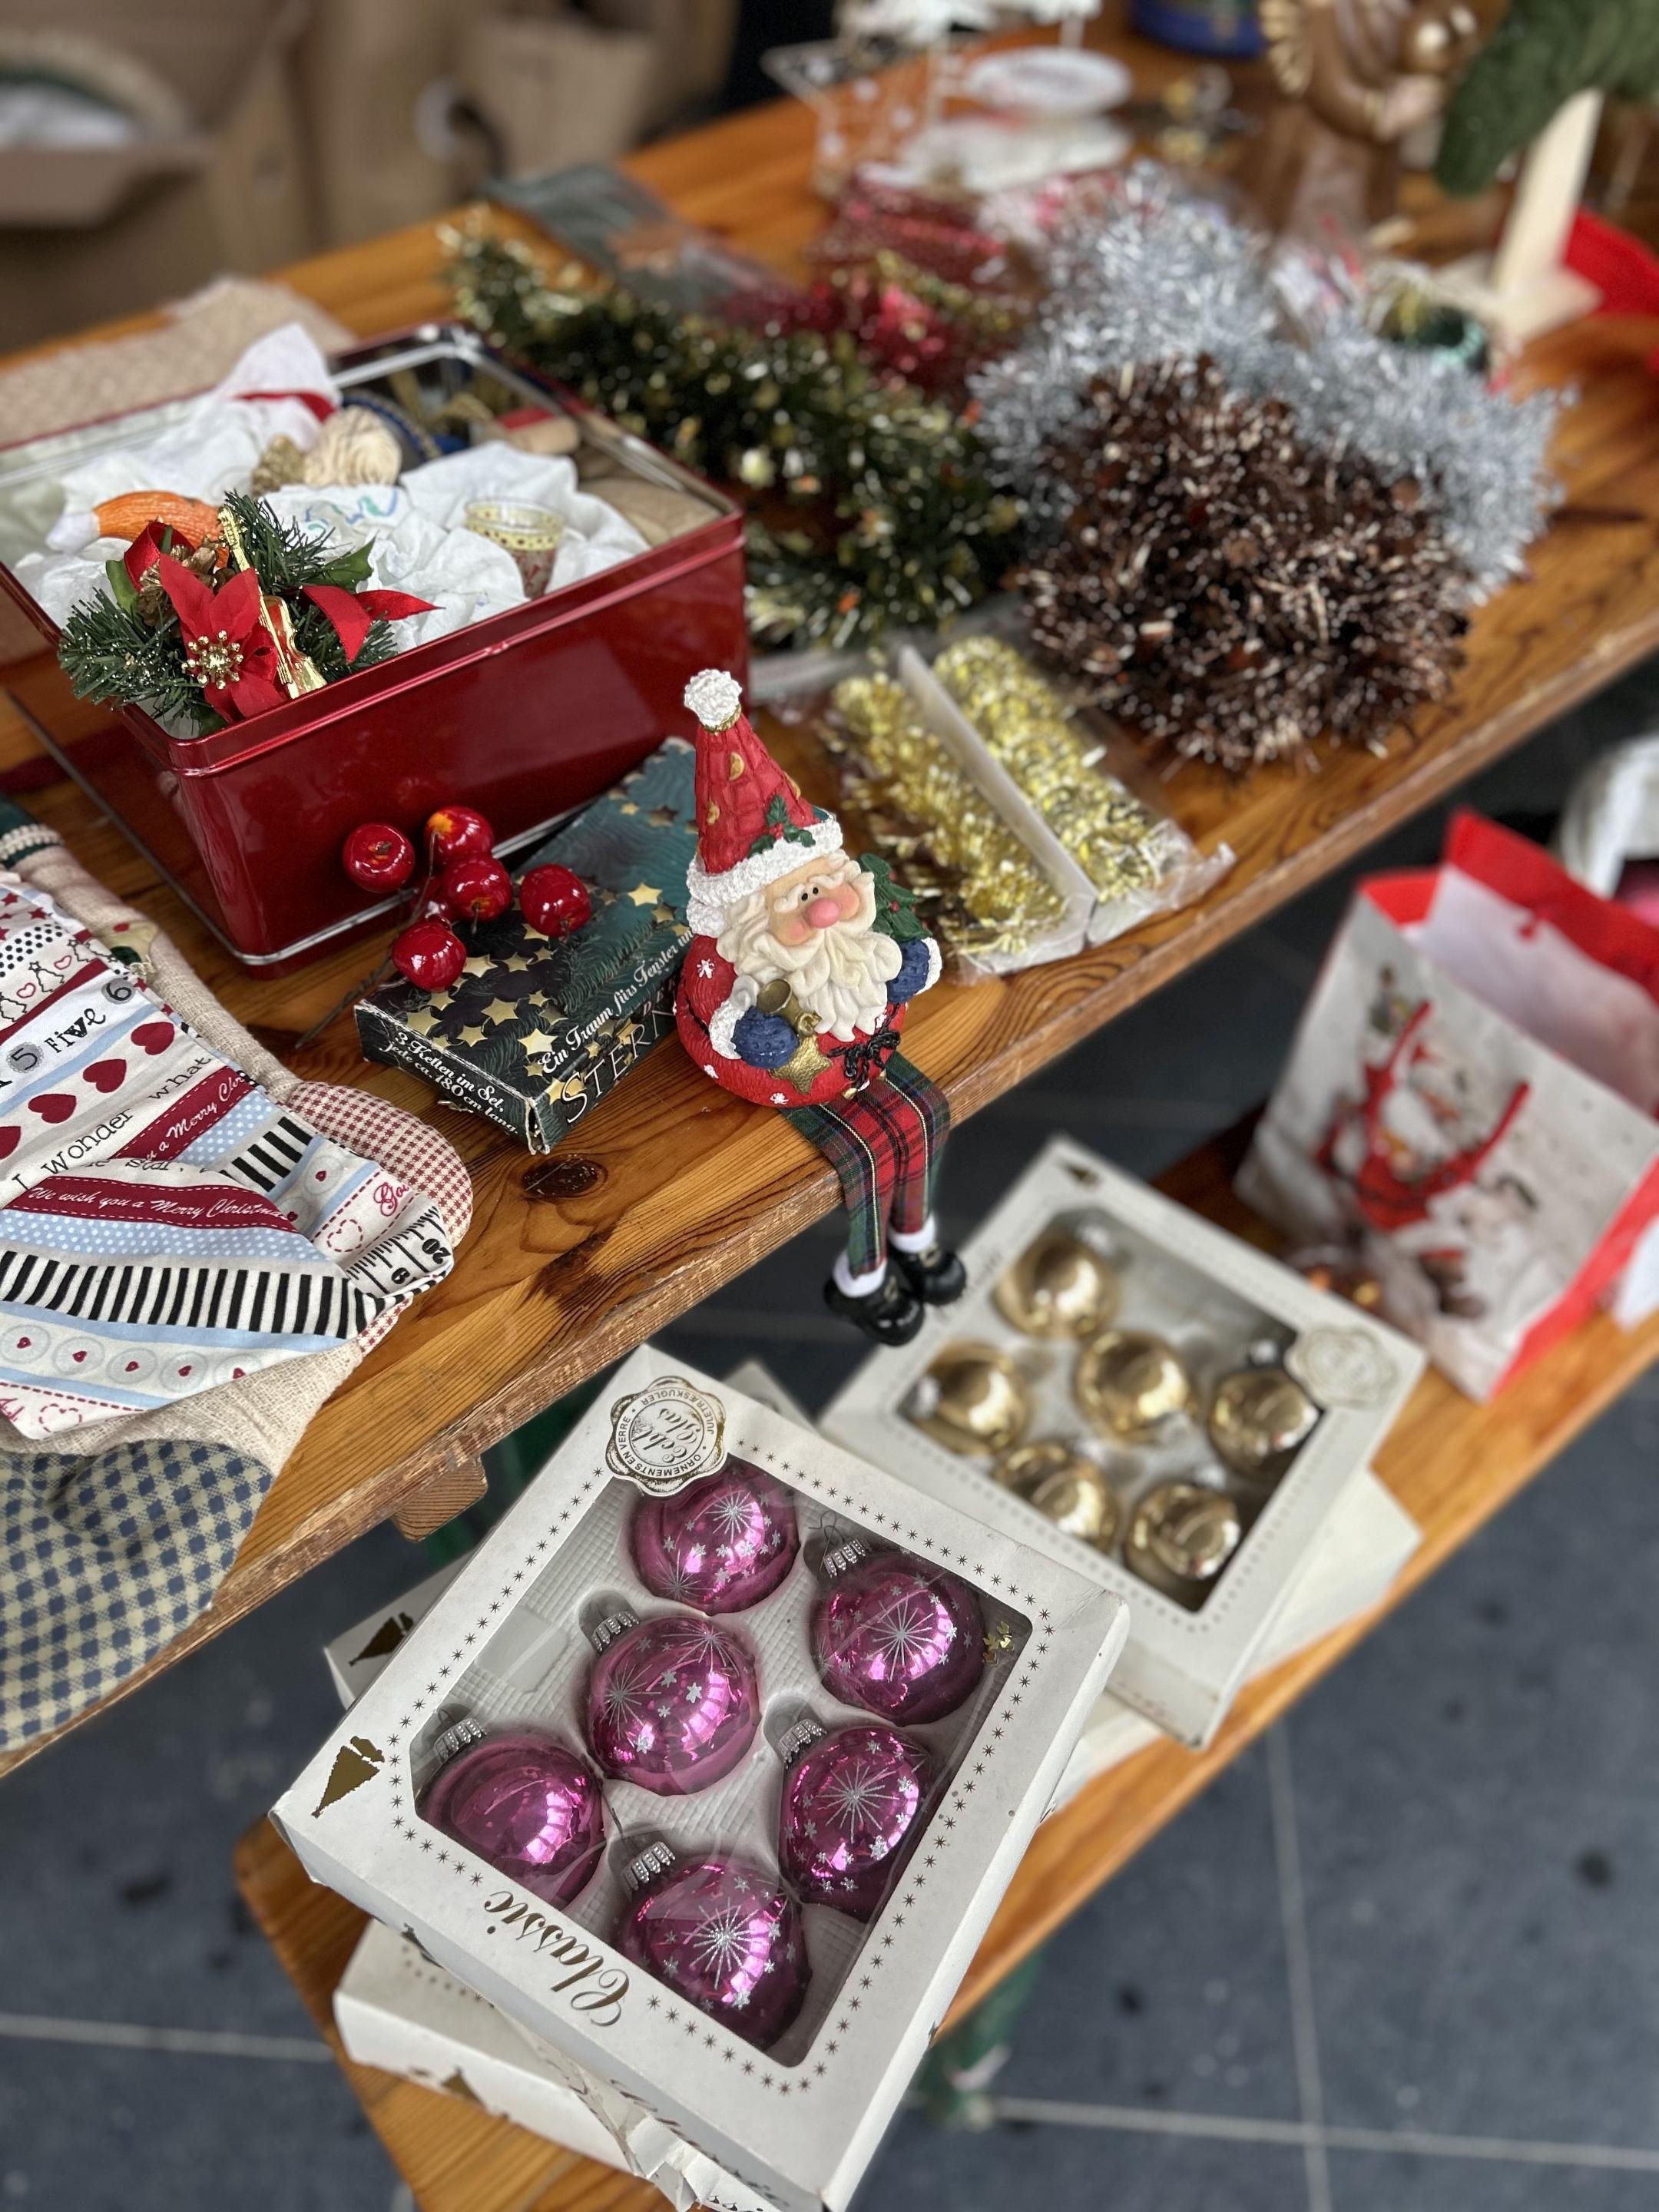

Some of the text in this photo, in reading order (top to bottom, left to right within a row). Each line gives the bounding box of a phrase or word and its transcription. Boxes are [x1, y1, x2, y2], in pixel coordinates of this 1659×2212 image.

[11, 1047, 38, 1070] 5
[106, 982, 131, 1001] 6
[538, 1050, 569, 1074] Ein
[565, 1005, 614, 1050] Traum
[613, 984, 637, 1017] fürs
[634, 945, 678, 987] Fenster
[147, 1057, 211, 1099] what
[395, 1031, 409, 1045] 3
[456, 1073, 475, 1092] im
[166, 1102, 217, 1138] Merry
[415, 1062, 432, 1078] ca.
[435, 1075, 464, 1097] 180
[463, 1096, 483, 1111] cm
[485, 1107, 518, 1134] lang.
[28, 1187, 55, 1200] We
[61, 1191, 101, 1204] wish
[99, 1197, 131, 1210] you
[132, 1200, 144, 1208] a
[151, 1200, 205, 1218] Merry
[618, 1416, 701, 1477] ORNEMENTS EN VERRE
[484, 1890, 630, 2027] Classic
